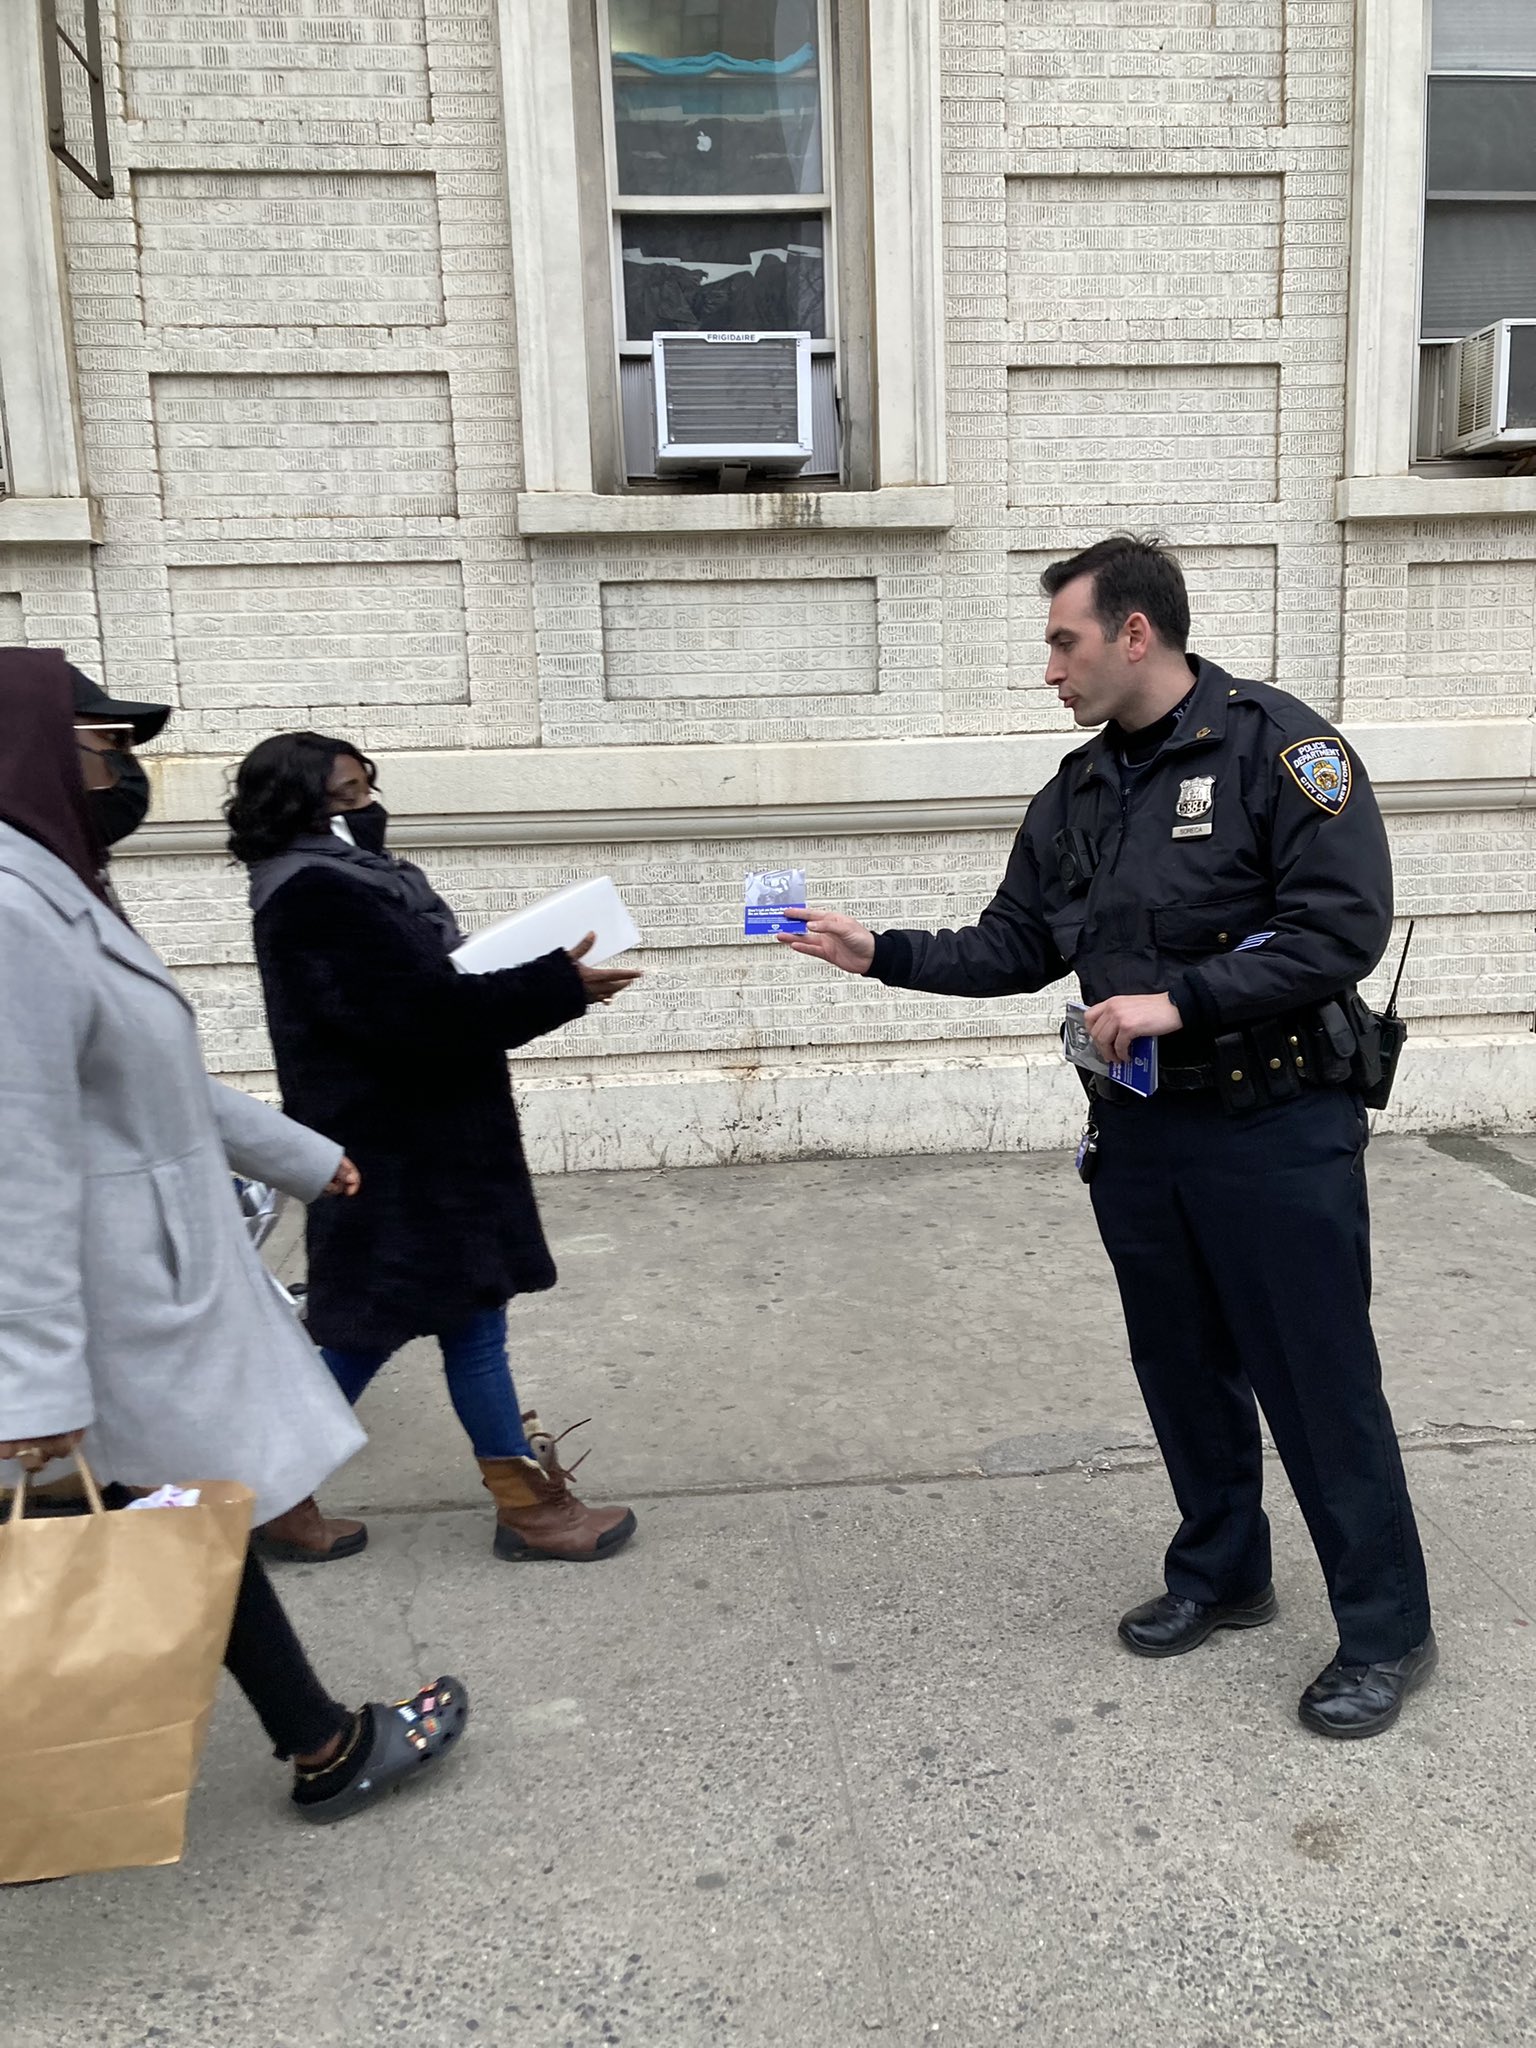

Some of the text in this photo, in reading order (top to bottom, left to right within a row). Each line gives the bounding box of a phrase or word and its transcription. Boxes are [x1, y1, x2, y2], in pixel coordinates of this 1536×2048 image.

[707, 333, 756, 341] FRIGIDAIRE
[1298, 742, 1327, 755] POLICE
[1293, 748, 1340, 768] DEPARTMENT
[1300, 776, 1328, 803] CITY OF
[1338, 784, 1347, 802] NEW
